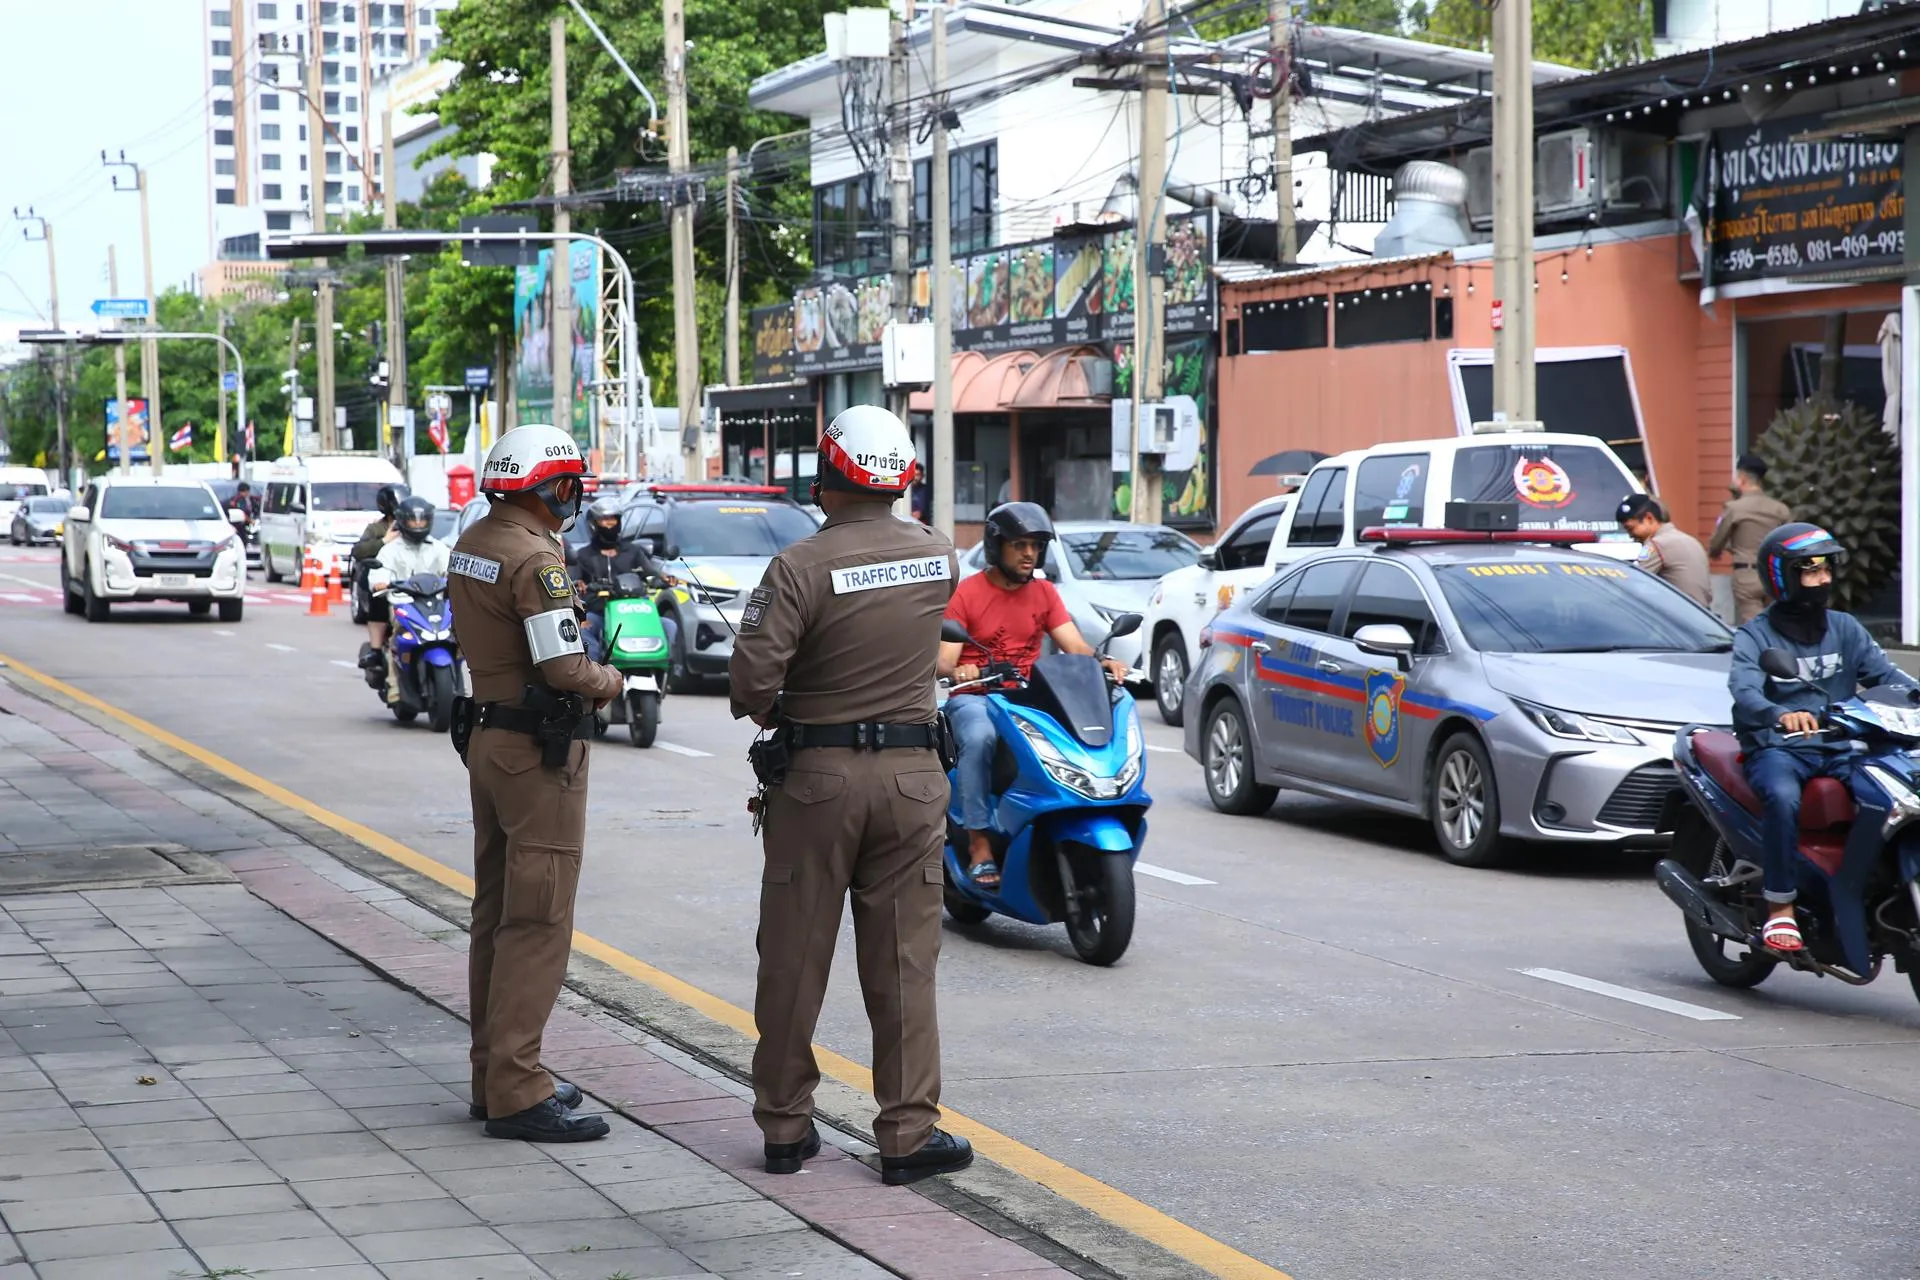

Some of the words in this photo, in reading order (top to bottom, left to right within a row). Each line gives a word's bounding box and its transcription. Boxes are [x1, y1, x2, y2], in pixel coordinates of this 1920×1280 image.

[1715, 244, 1803, 271] -596-6526,
[545, 445, 574, 457] 6018
[469, 560, 497, 580] POLICE
[842, 566, 898, 588] TRAFFIC
[900, 560, 943, 580] POLICE
[1466, 564, 1549, 577] TOURIST
[1560, 563, 1629, 580] POLICE
[617, 602, 653, 614] Grab
